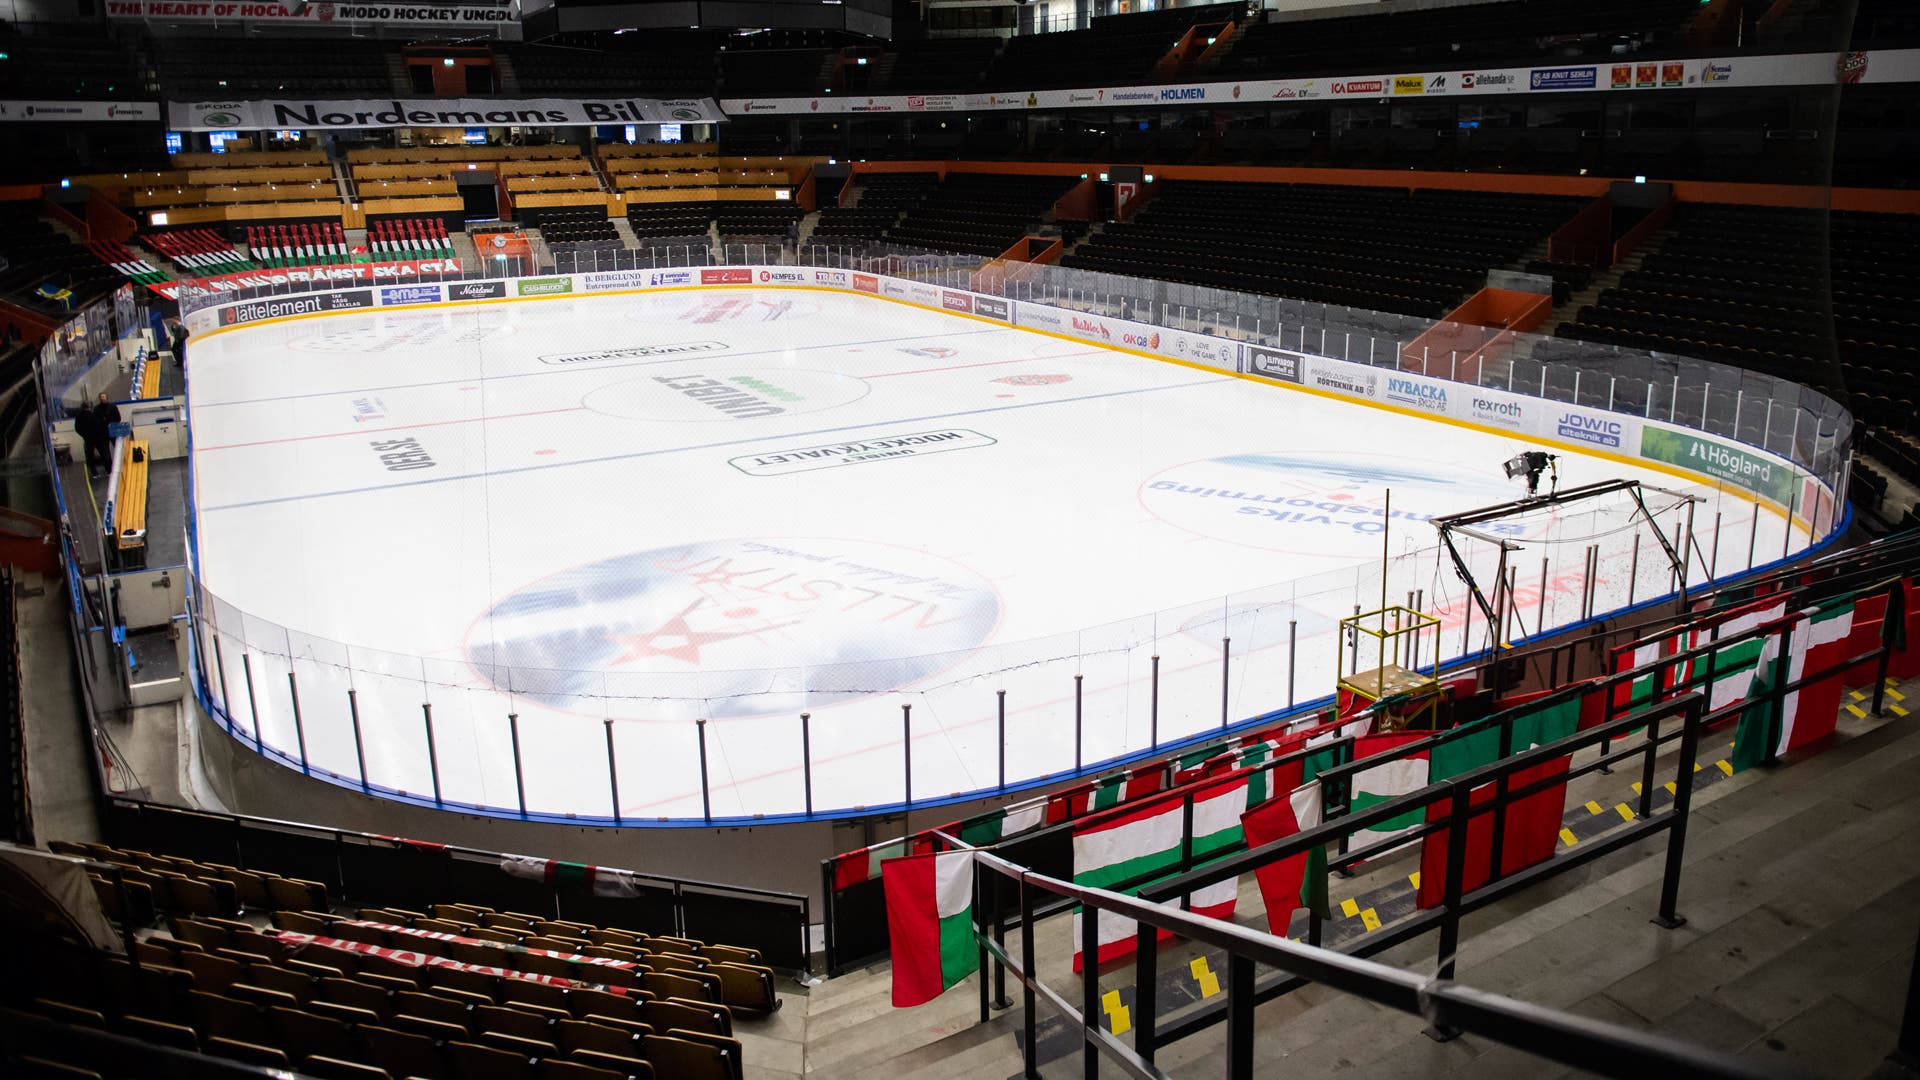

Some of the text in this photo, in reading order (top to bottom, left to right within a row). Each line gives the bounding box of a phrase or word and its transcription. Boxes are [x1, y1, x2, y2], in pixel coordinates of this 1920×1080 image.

[107, 2, 314, 18] THE HEART OF HOCKY
[339, 6, 391, 20] MODO
[393, 7, 459, 20] HOCKEY
[1551, 71, 1568, 79] KNUT
[1569, 70, 1594, 79] SEHLIN
[1161, 88, 1205, 100] HOLMEN
[1299, 90, 1307, 98] EY
[1331, 82, 1381, 94] ICA KVANTUM
[1113, 92, 1154, 100] Handelsbanken
[273, 100, 645, 127] Nordemans Bil
[373, 264, 416, 278] SKA
[420, 258, 460, 273] STÅ
[595, 273, 641, 282] BERGLUND
[771, 272, 796, 280] KEMPES
[586, 282, 630, 290] Entreprenad
[236, 296, 322, 322] lättelement
[1123, 333, 1148, 347] OKQ8
[1196, 342, 1210, 350] LOVE
[558, 344, 712, 363] HOCKEYKVALET
[1191, 350, 1217, 361] THE GAME
[651, 373, 787, 420] UNIBET
[1355, 385, 1365, 394] AB
[1388, 378, 1447, 401] NYBACKA
[1435, 401, 1447, 411] AB
[1473, 397, 1522, 418] rexroth
[1558, 412, 1621, 435] JOWIC
[1560, 427, 1616, 446] elteknik ab
[754, 430, 964, 467] HOCKEYKVALET
[841, 448, 916, 464] UNIBET
[1236, 504, 1387, 536] Ö-viks
